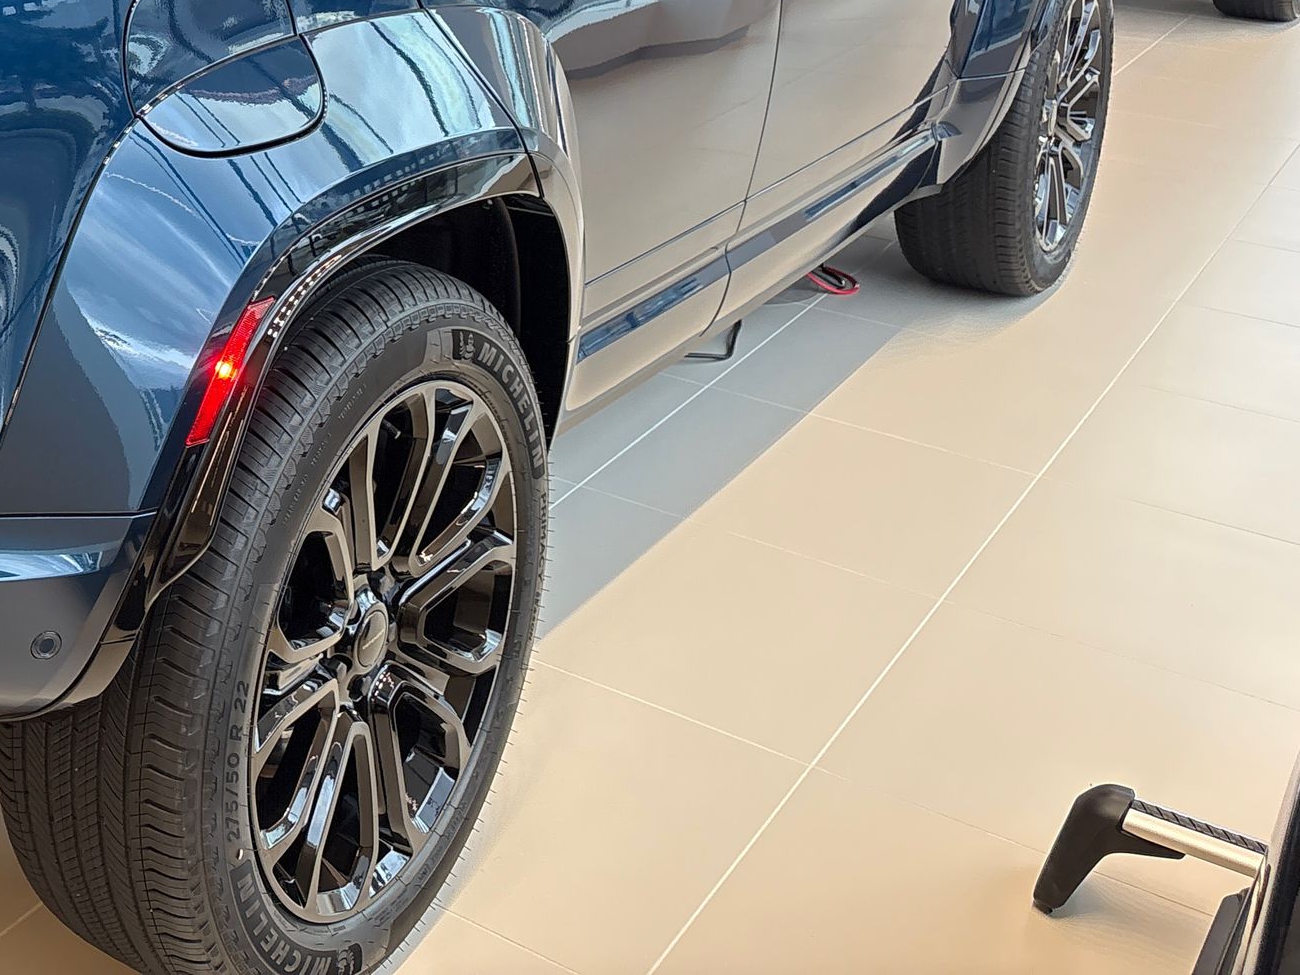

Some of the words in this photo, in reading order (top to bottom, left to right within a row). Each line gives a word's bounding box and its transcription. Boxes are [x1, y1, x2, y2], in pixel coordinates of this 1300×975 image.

[478, 342, 544, 469] MICHELIN
[538, 491, 547, 582] PRIMACY
[229, 725, 243, 741] R
[234, 680, 249, 713] 22
[225, 752, 241, 843] 275/50
[237, 873, 332, 975] MICHELIN
